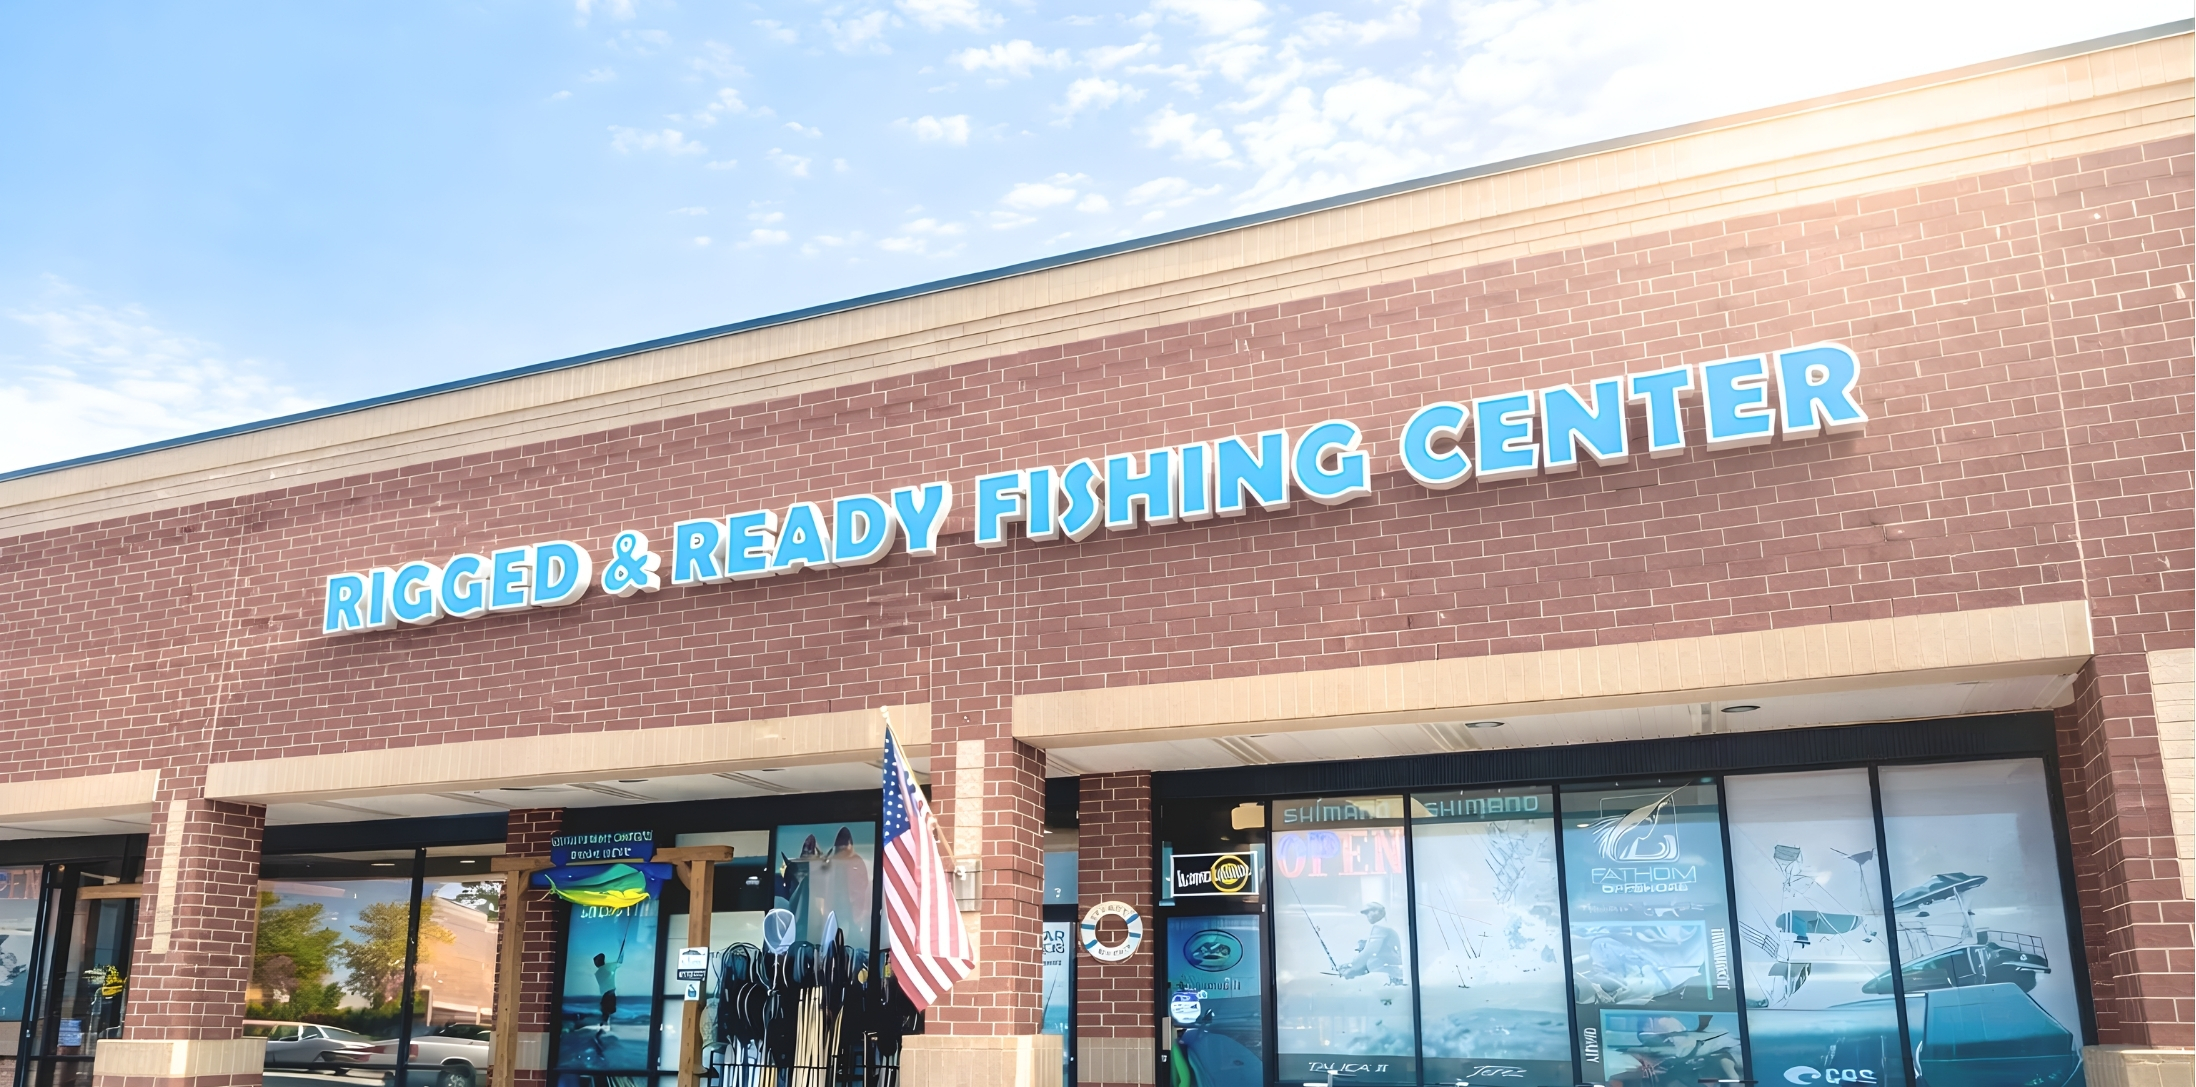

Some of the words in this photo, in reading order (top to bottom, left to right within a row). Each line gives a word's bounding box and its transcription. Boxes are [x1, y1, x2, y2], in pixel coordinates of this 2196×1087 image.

[322, 540, 592, 635] RIGGED
[601, 529, 661, 598] &
[671, 481, 953, 586] READY
[974, 418, 1371, 548] FISHING
[1399, 341, 1869, 490] CENTER
[1276, 830, 1402, 878] OPEN
[1591, 865, 1697, 884] FATHOM
